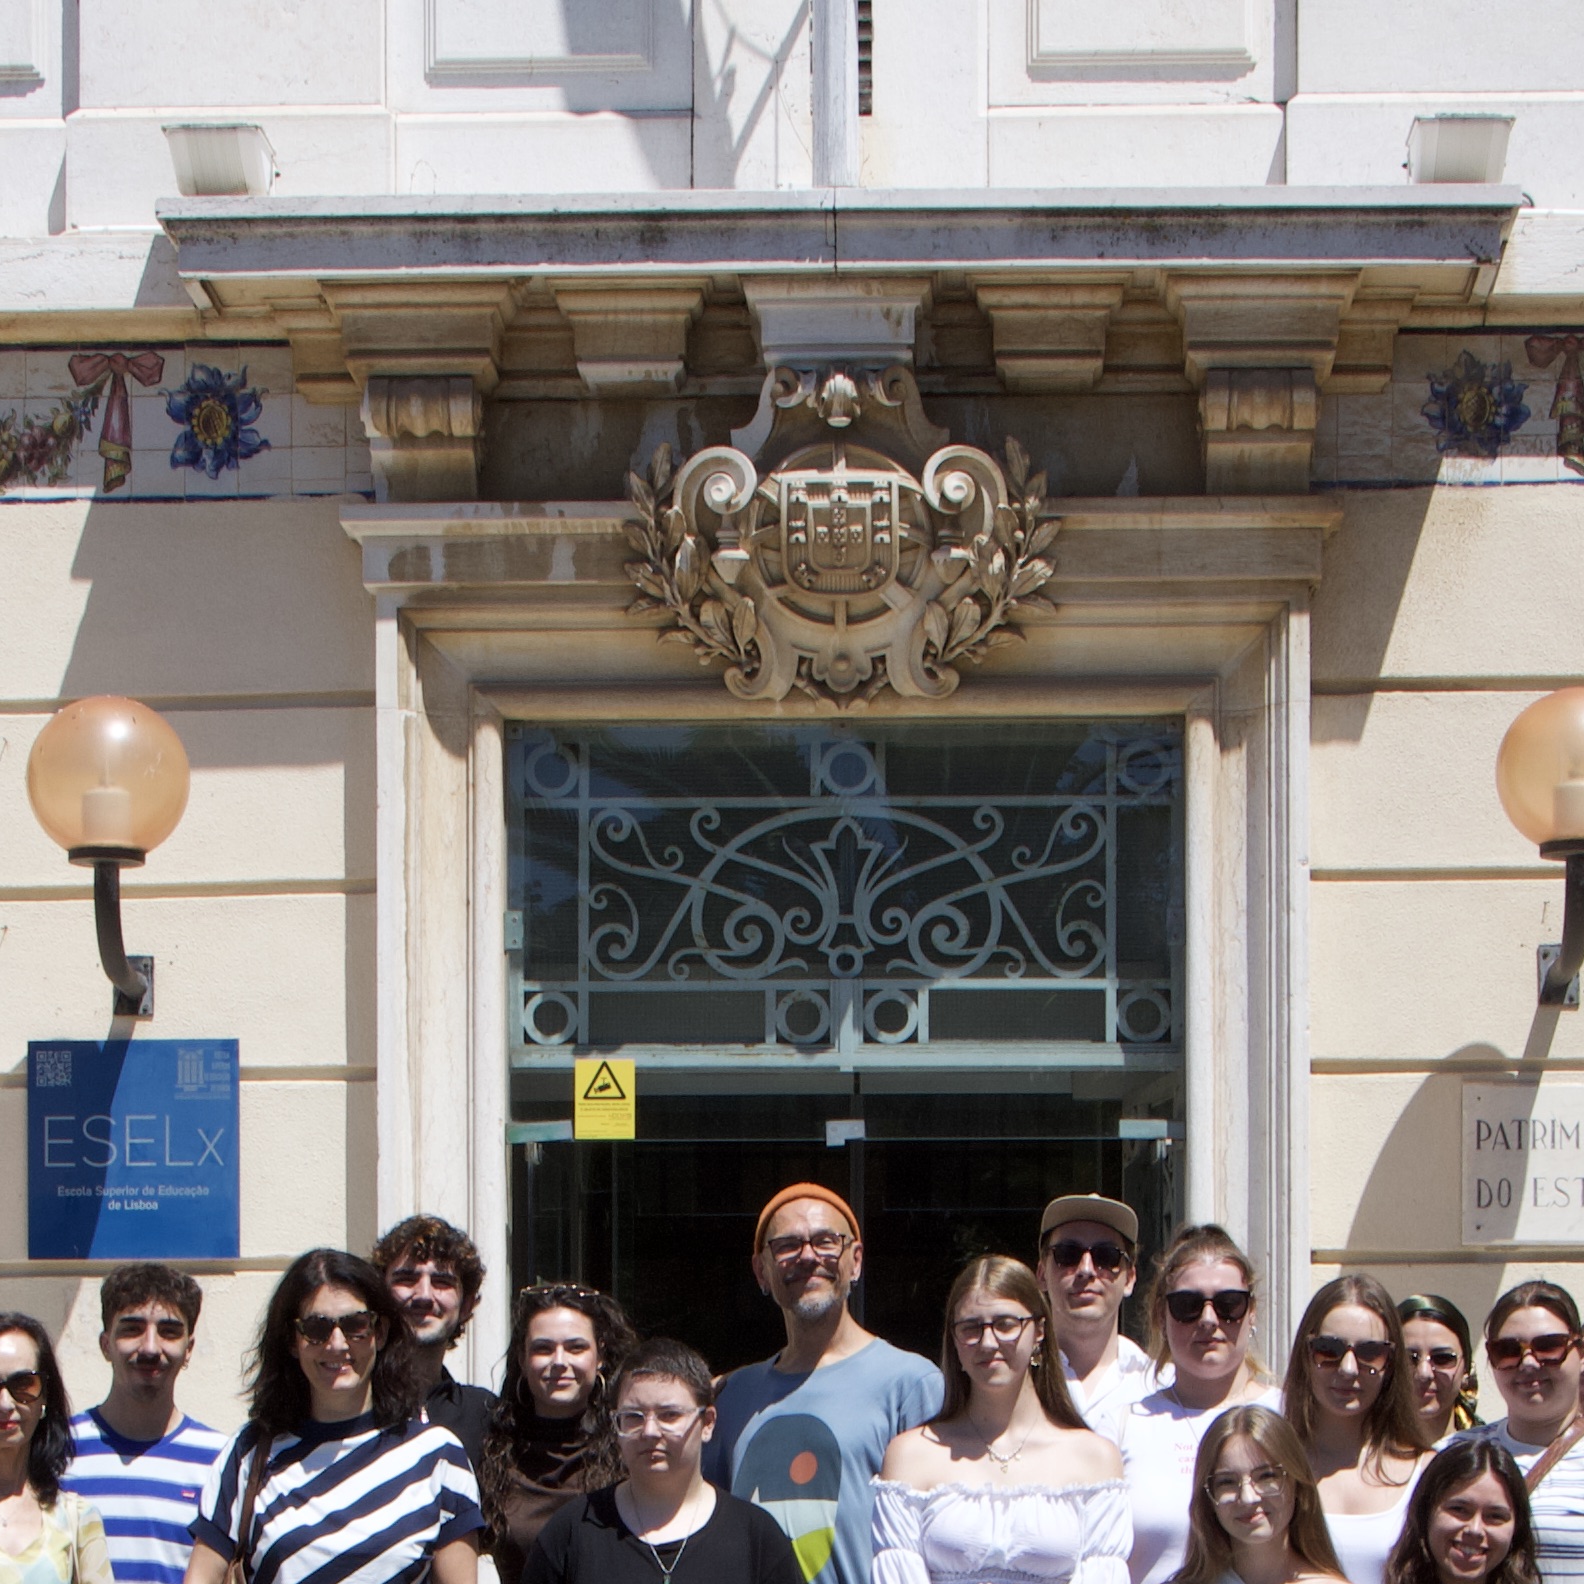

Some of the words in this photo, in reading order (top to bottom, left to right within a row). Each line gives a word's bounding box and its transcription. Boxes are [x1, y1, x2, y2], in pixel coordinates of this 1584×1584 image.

[57, 1185, 92, 1197] Escola
[95, 1185, 139, 1198] Superior
[142, 1185, 155, 1196] de
[158, 1185, 210, 1198] Educação
[1476, 1178, 1512, 1209] DO
[108, 1199, 121, 1211] de
[124, 1199, 159, 1211] Lisboa
